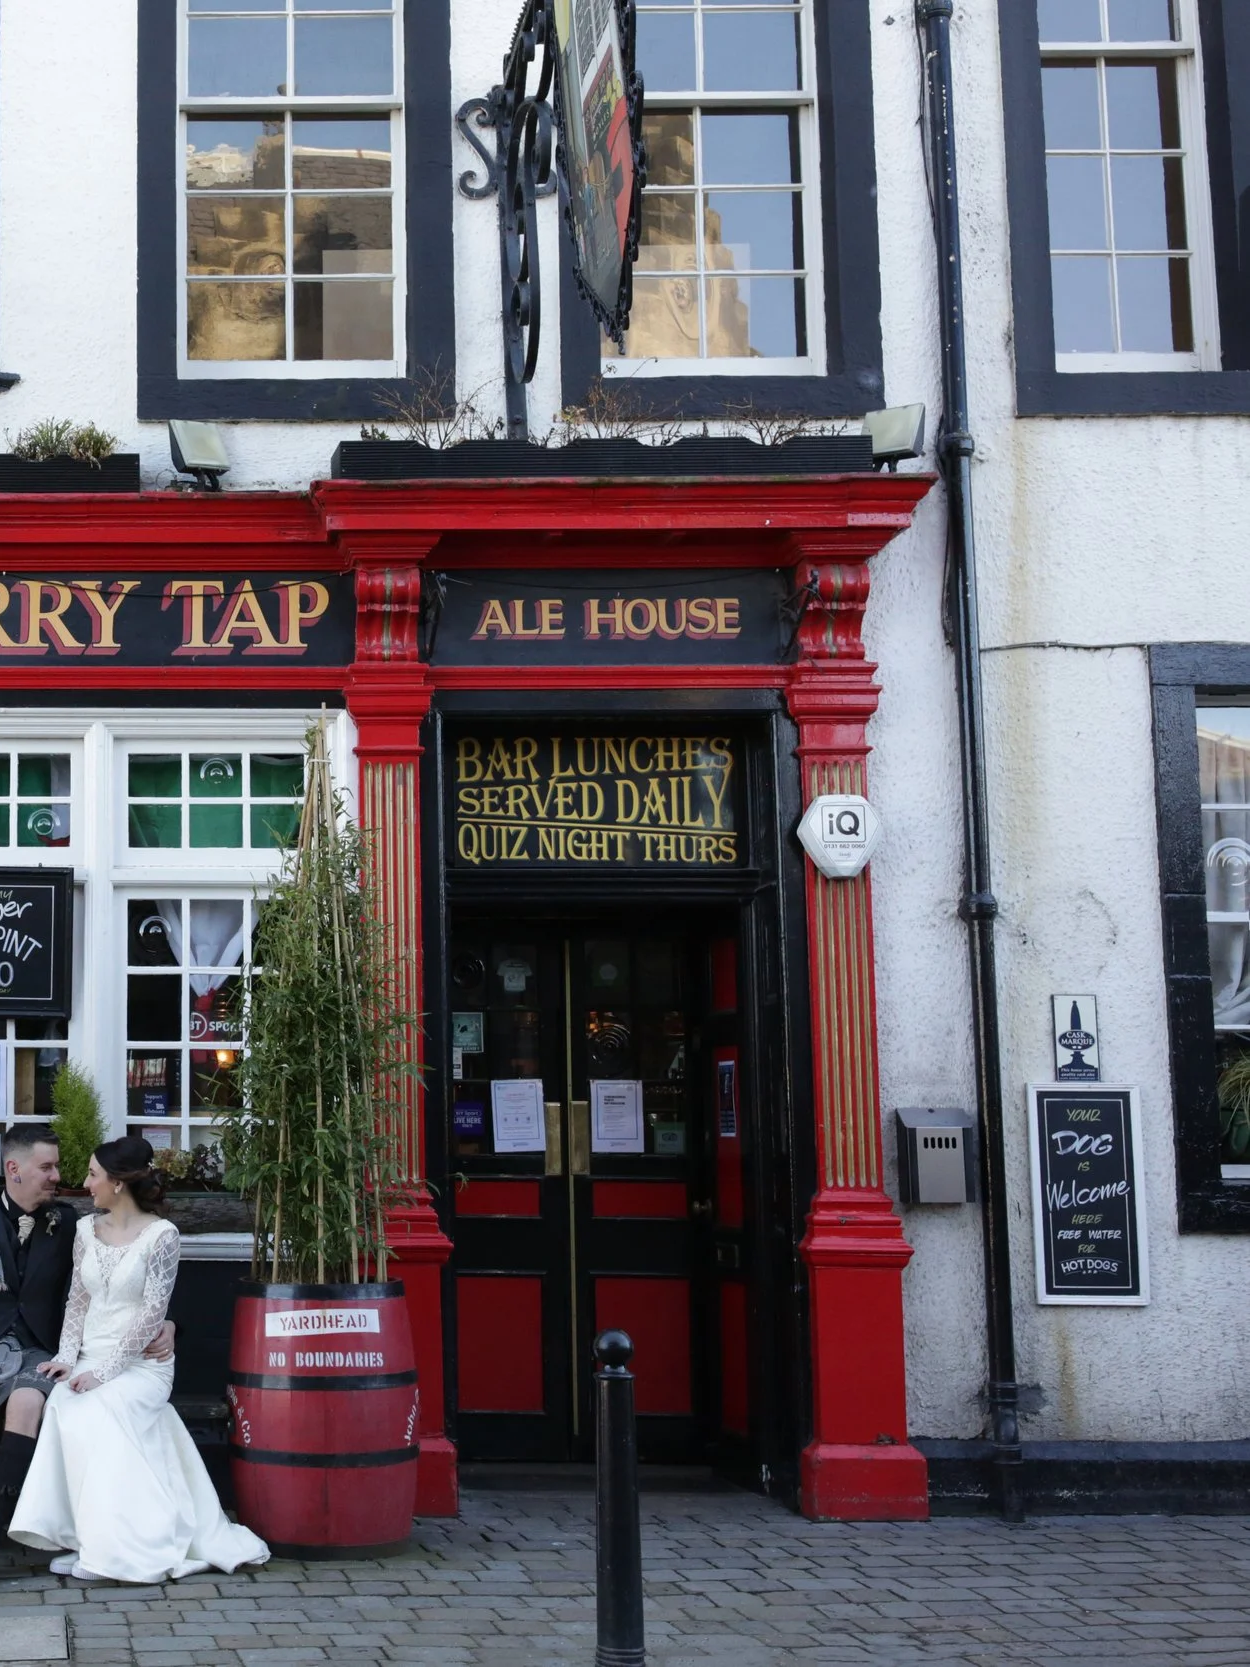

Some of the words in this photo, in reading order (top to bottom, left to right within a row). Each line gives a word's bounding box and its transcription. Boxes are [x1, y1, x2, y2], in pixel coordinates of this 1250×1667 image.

[161, 578, 330, 656] TAP
[470, 598, 566, 641] ALE
[582, 598, 742, 641] HOUSE
[456, 736, 541, 783] BAR
[551, 736, 733, 778] LUNCHES
[456, 775, 605, 821] SERVED
[614, 762, 734, 829] DAILY
[828, 810, 860, 837] iQ
[457, 823, 531, 865] QUIZ
[536, 828, 631, 862] NIGHT
[637, 832, 738, 864] THURS
[1061, 1038, 1094, 1046] MARQUE
[1066, 1031, 1086, 1039] CASK
[1066, 1108, 1102, 1122] YOUR
[1051, 1130, 1113, 1156] DOG
[1077, 1161, 1091, 1172] IS
[1046, 1178, 1130, 1212] Welcome
[1071, 1213, 1103, 1225] HERE
[1057, 1229, 1082, 1240] FREE
[1088, 1229, 1122, 1240] WATER
[1077, 1243, 1098, 1254] FOR
[1061, 1258, 1085, 1274] HOT
[1085, 1257, 1119, 1274] DOGS
[279, 1313, 368, 1331] YARDHEAD
[268, 1352, 287, 1367] NO
[295, 1352, 384, 1367] BOUNDARIES
